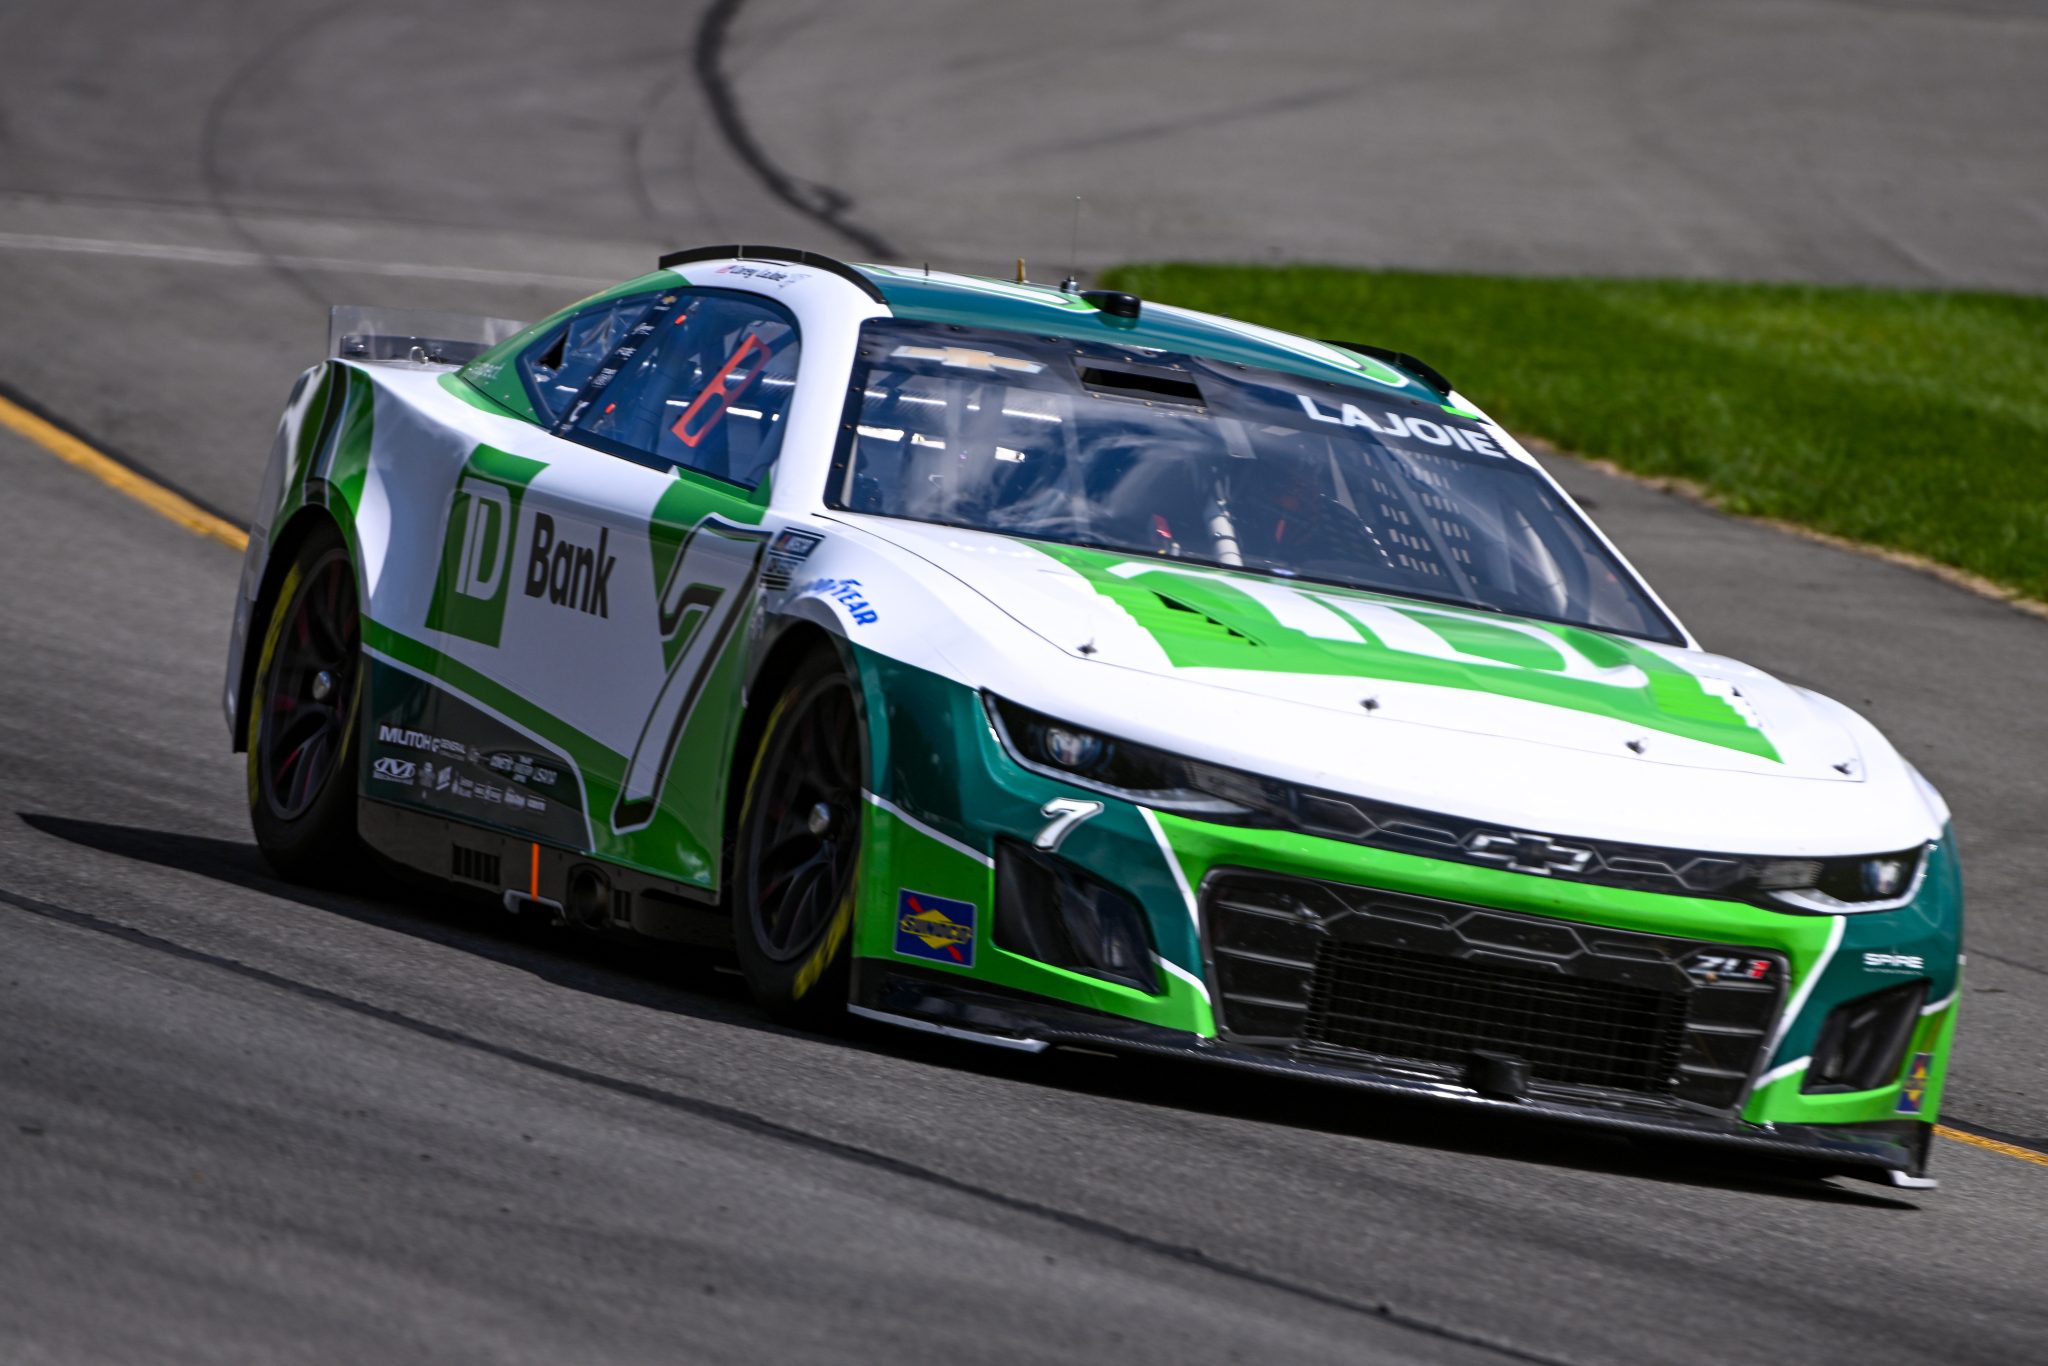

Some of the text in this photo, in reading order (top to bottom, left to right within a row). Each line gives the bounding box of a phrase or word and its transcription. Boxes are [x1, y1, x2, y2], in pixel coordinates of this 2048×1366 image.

[1296, 394, 1508, 459] LAJOIE
[455, 475, 617, 619] TD Bank
[610, 512, 774, 836] 7
[379, 724, 433, 752] MUTOH
[1033, 797, 1104, 852] 7
